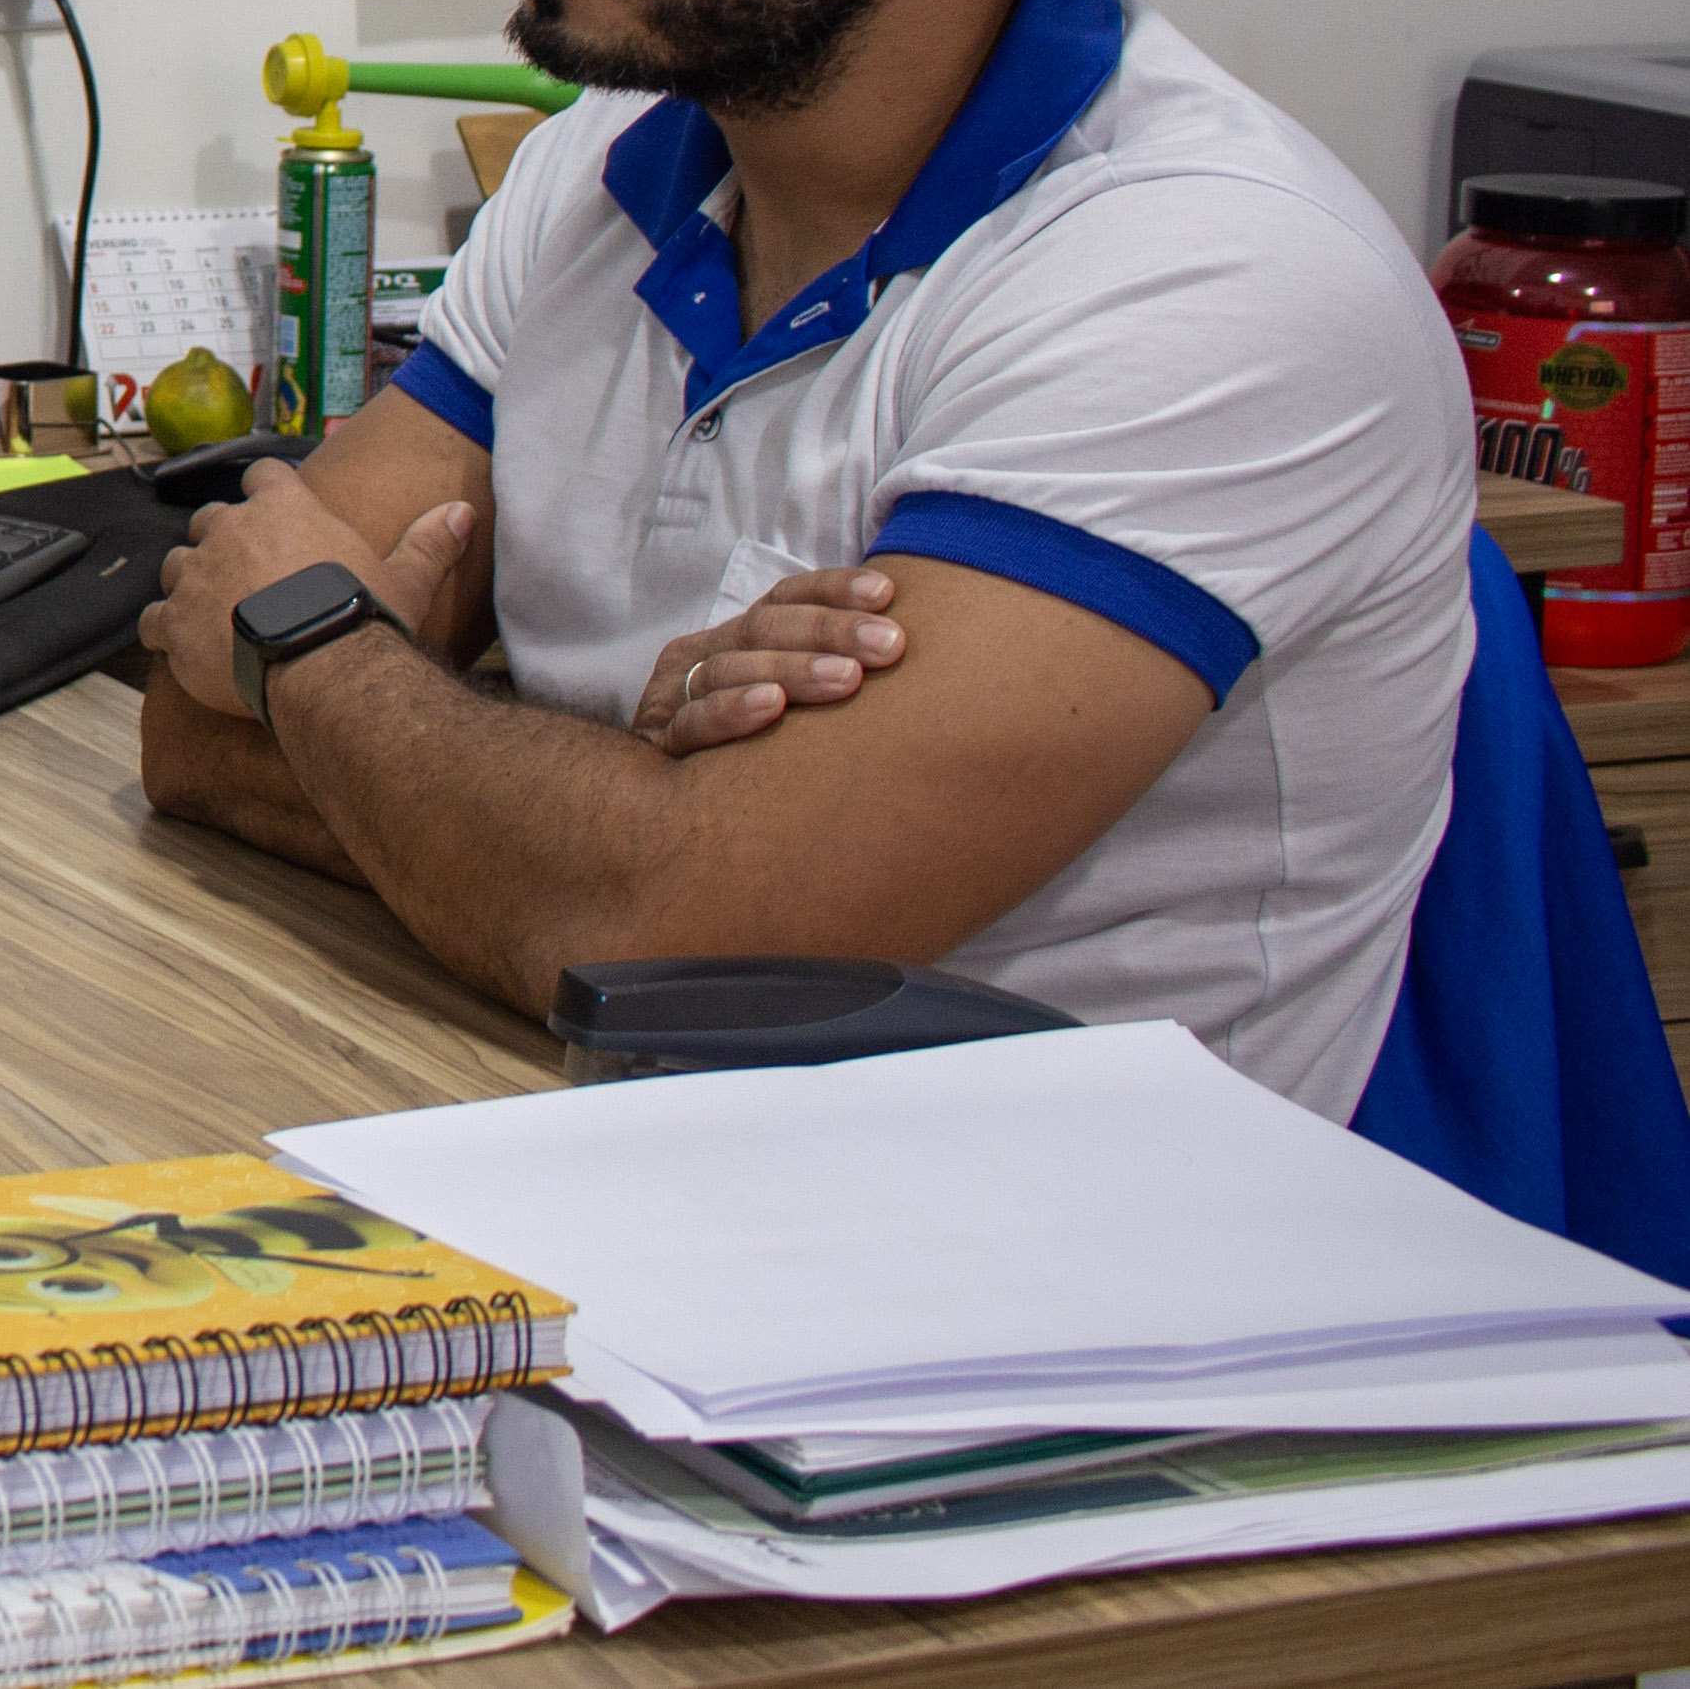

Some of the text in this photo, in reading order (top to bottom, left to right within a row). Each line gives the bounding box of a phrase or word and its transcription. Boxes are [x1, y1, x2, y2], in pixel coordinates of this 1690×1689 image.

[89, 238, 138, 249] VEREIRO
[169, 278, 185, 289] 10
[208, 277, 222, 286] 11
[95, 295, 229, 313] 15 16 17 18
[100, 316, 234, 334] 22 23 24 25
